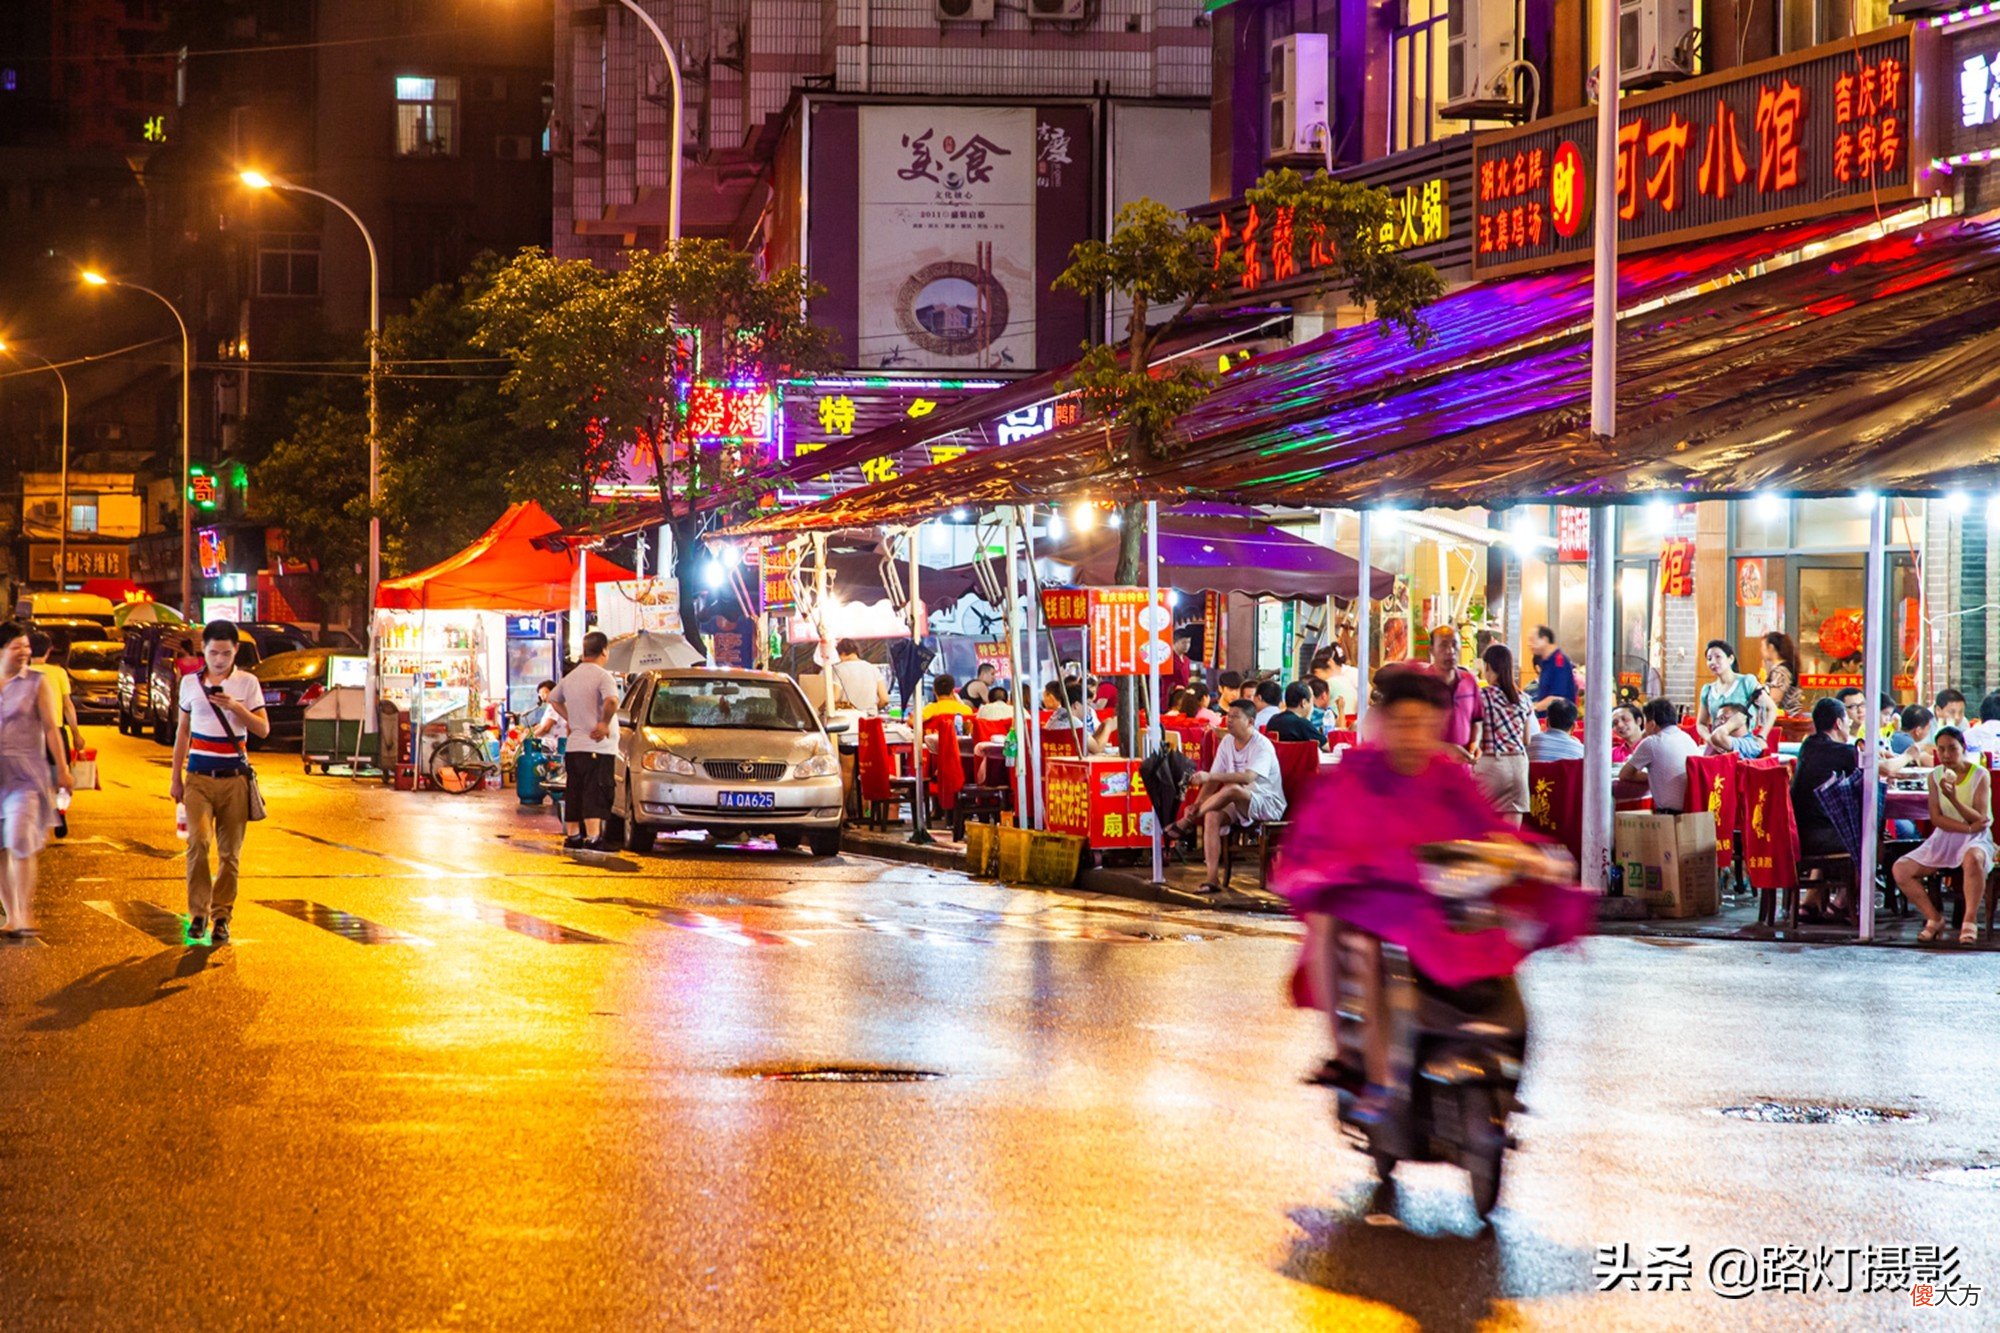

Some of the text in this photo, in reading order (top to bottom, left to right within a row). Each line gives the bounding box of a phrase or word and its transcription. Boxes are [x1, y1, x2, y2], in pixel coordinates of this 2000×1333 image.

[1834, 59, 1901, 124] 吉庆街
[898, 127, 1012, 184] 美食
[1480, 148, 1543, 200] 湖北名牌
[1834, 117, 1899, 182] 老字号
[1480, 201, 1542, 253] 汪集鸡汤
[40, 552, 119, 574] 一制冷维修
[736, 794, 774, 807] QA625
